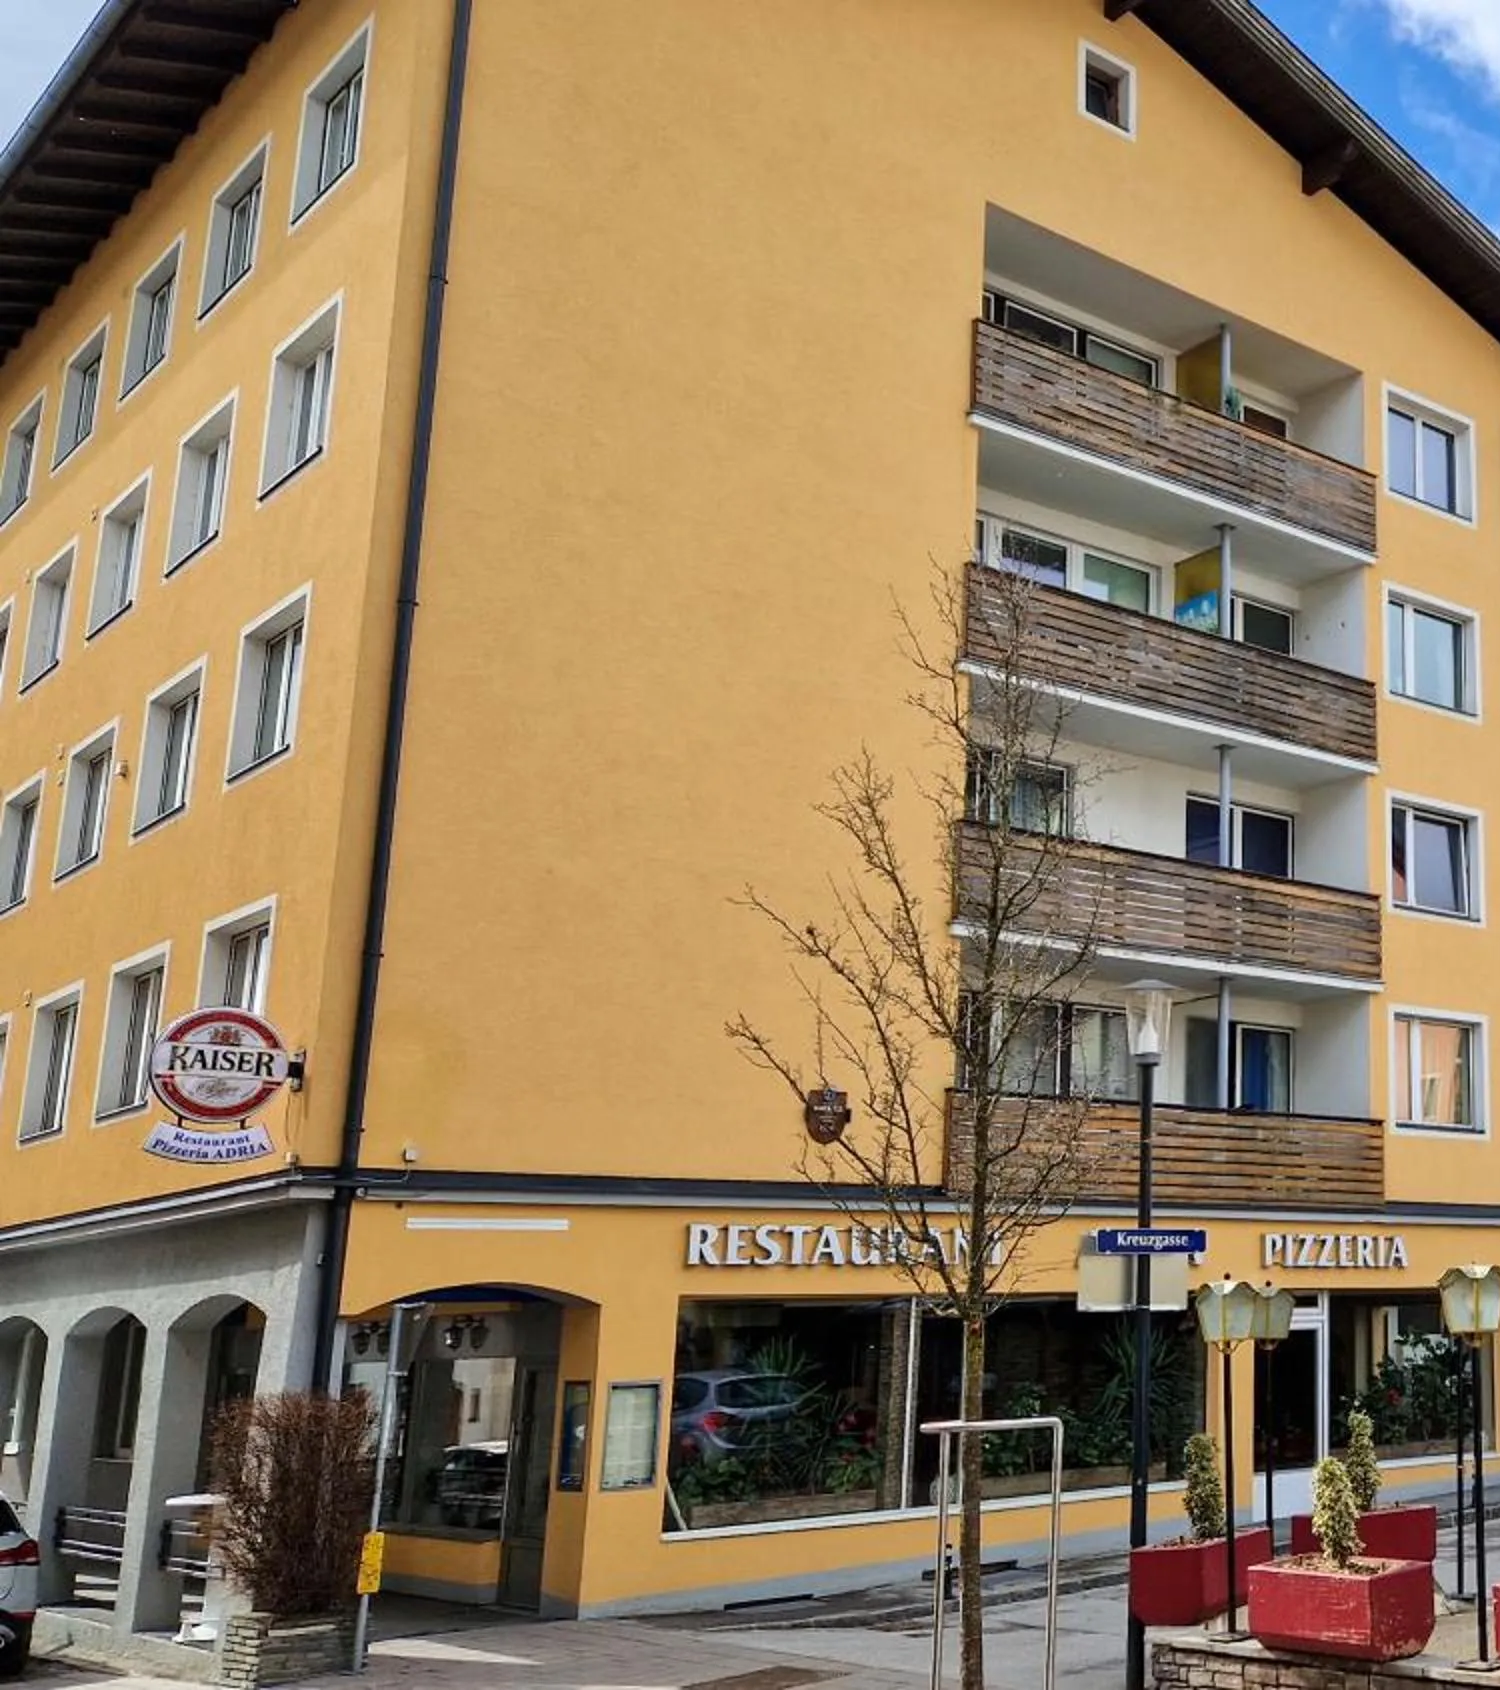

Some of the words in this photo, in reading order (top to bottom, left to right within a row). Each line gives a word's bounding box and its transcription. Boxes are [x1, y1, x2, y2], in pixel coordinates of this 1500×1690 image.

[168, 1045, 275, 1077] KAISER
[151, 1138, 209, 1159] Pizzeria
[212, 1142, 267, 1159] ADRIA
[173, 1130, 250, 1147] Restaurant
[1116, 1231, 1189, 1250] Kreuzgasse
[1263, 1233, 1409, 1268] PIZZERIA
